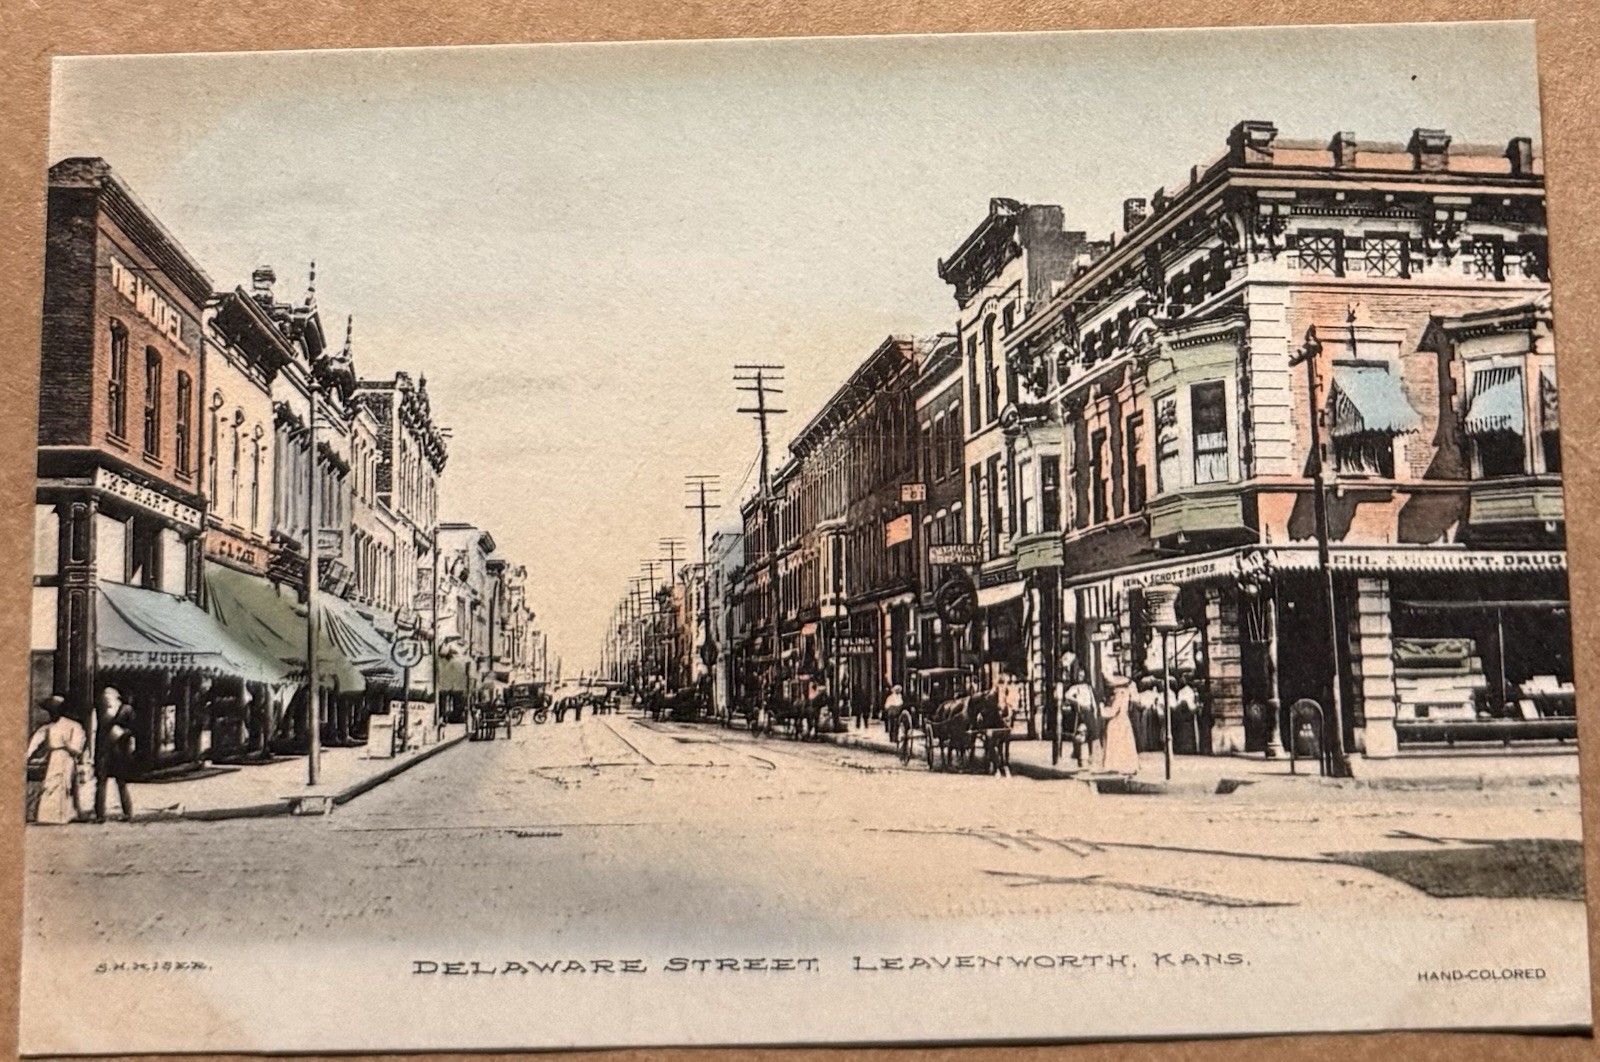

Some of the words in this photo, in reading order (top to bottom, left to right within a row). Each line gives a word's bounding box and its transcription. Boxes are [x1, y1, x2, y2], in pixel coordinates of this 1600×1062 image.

[109, 256, 136, 303] THE
[1333, 555, 1377, 565] EHL
[149, 652, 197, 664] MODEL
[412, 960, 648, 975] DELAWARE
[1152, 951, 1251, 968] KANS.
[1417, 967, 1547, 981] HAND-COLORED
